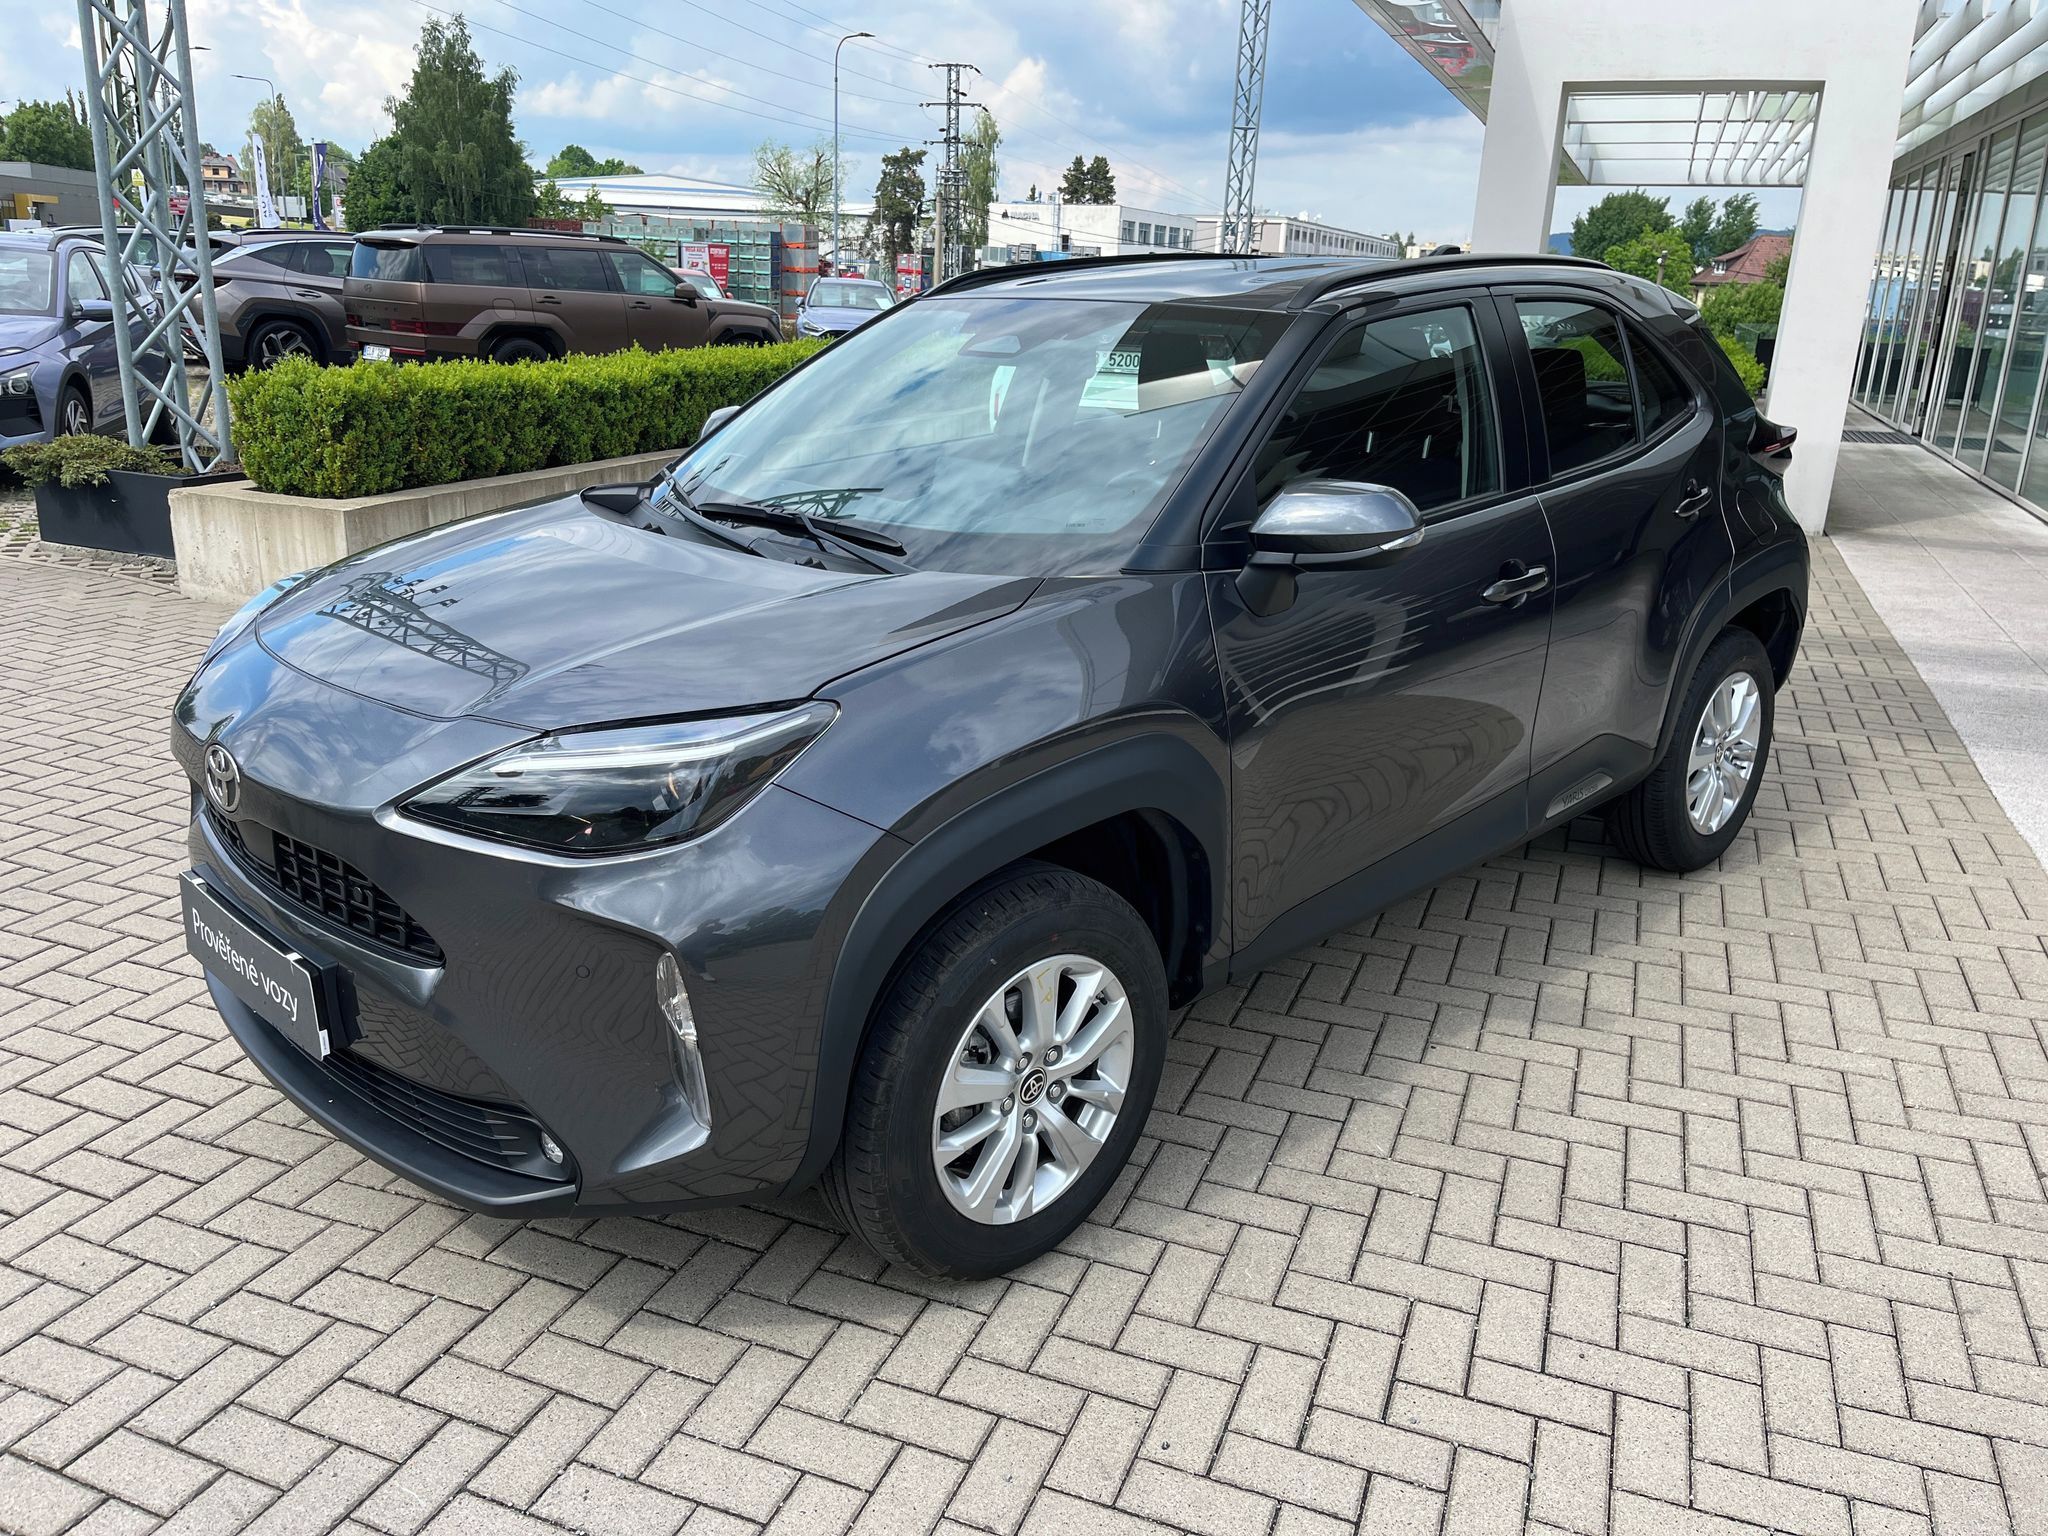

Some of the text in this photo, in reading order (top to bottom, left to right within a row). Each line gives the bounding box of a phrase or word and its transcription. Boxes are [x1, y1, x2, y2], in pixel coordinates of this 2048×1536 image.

[1108, 353, 1140, 368] 5200
[191, 907, 298, 1022] Prověřené vozy
